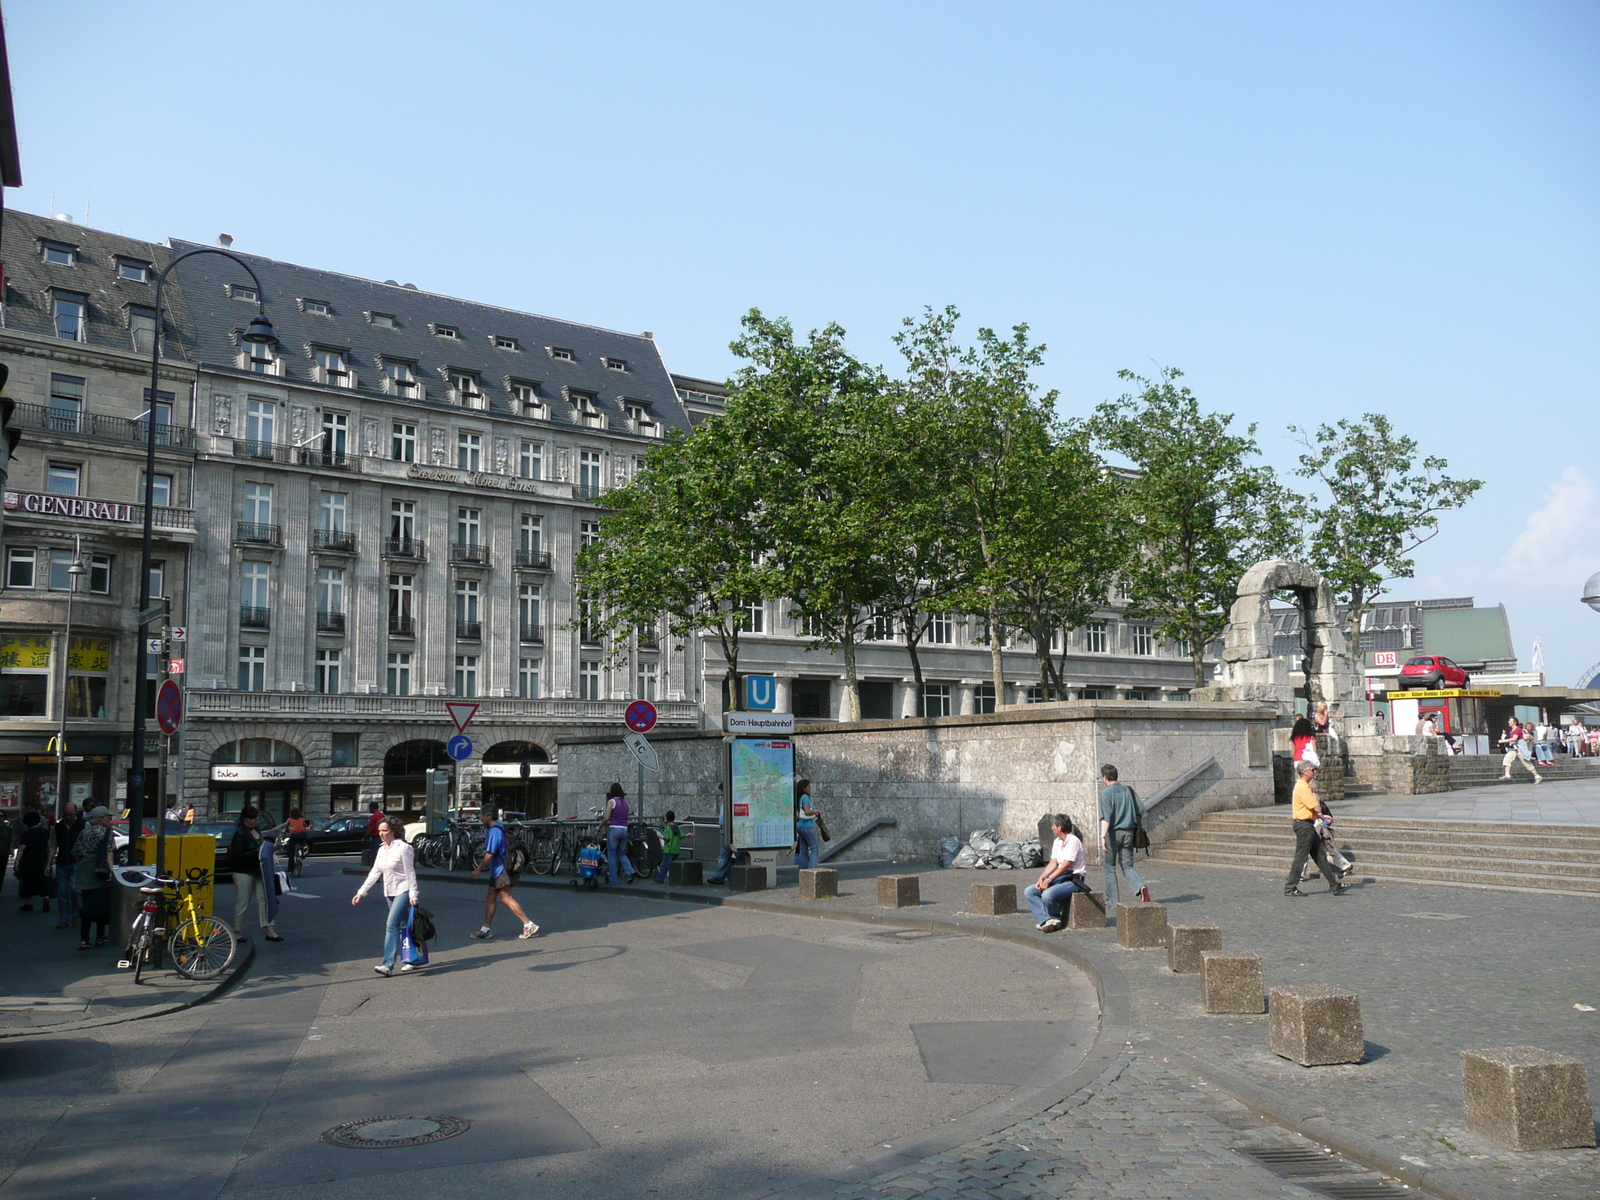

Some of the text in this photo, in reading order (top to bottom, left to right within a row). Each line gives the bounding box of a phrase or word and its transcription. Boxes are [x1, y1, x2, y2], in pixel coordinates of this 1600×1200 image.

[406, 463, 538, 493] Excelsior Hotel Ernst
[25, 493, 133, 522] GENERALI
[1376, 653, 1394, 664] DB
[752, 679, 770, 705] U
[730, 718, 792, 728] Dom/Hauptbahnhof
[633, 739, 646, 754] WC
[217, 769, 239, 778] taku
[260, 769, 286, 778] taku
